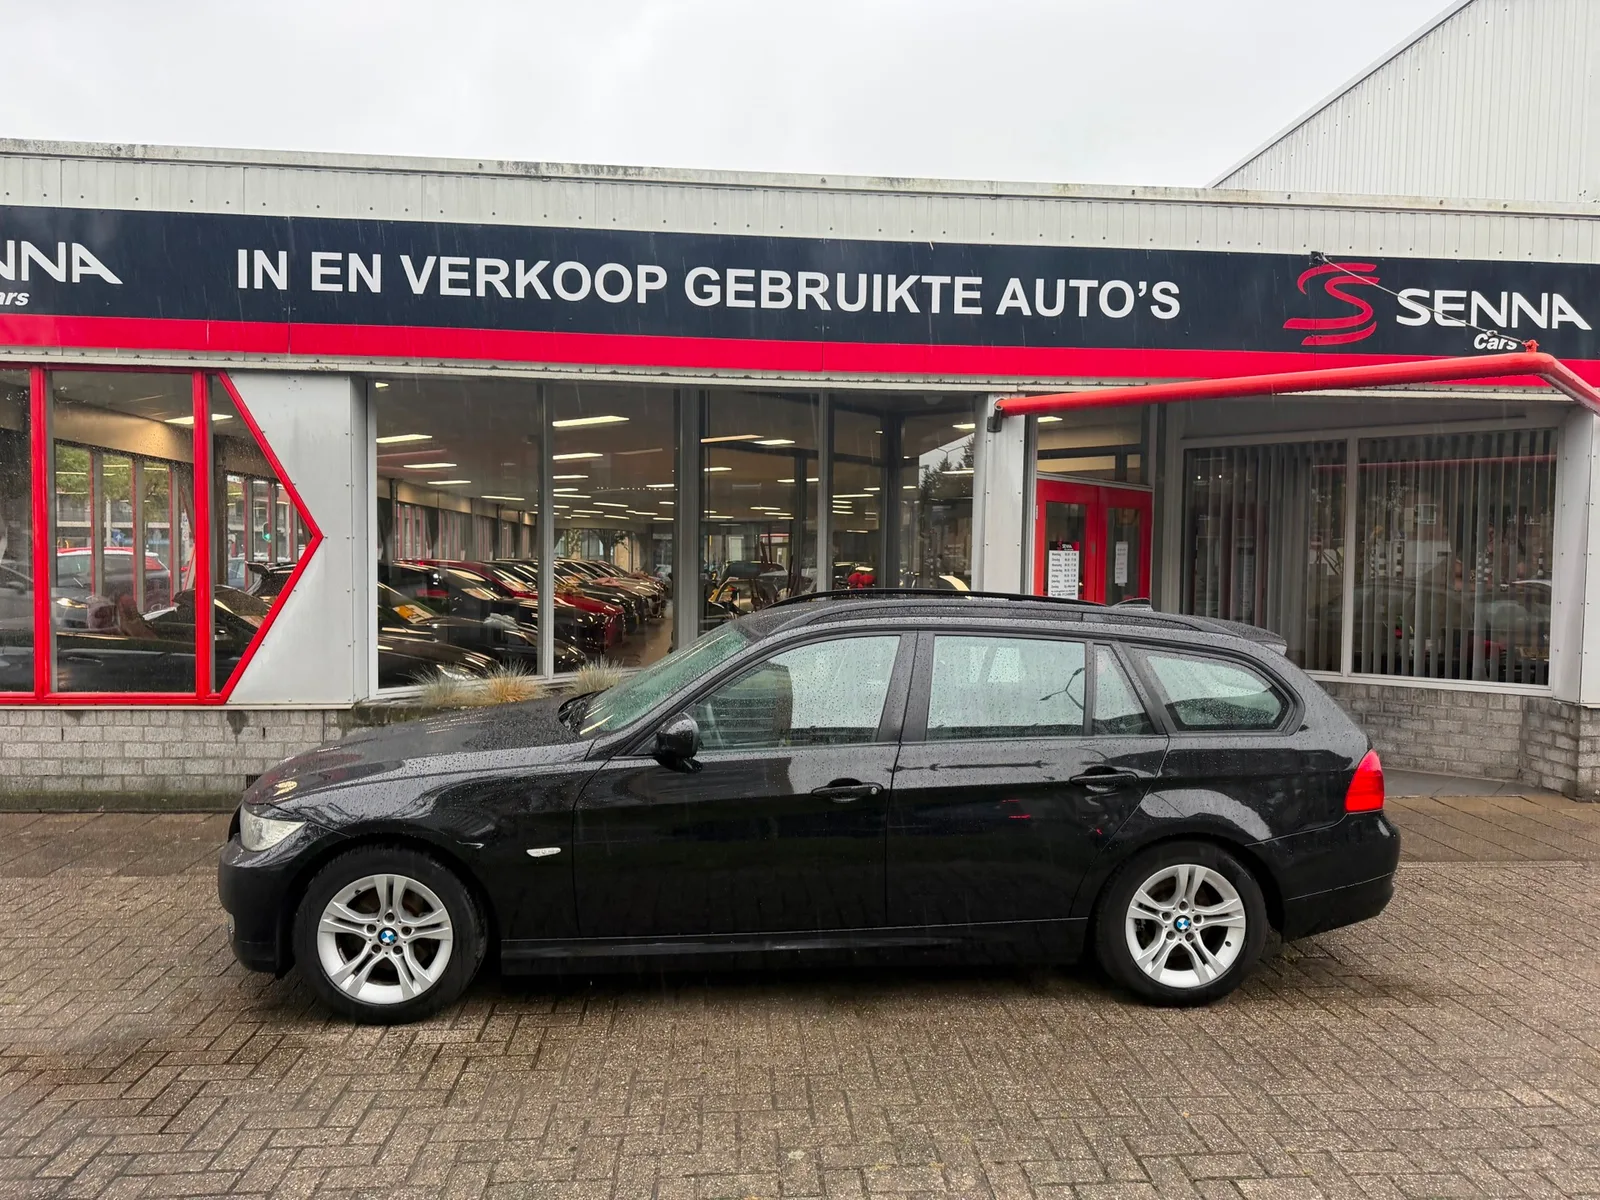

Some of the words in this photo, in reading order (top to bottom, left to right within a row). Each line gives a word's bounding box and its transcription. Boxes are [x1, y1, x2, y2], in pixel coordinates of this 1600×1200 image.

[237, 248, 288, 291] IN
[311, 251, 382, 294] EN
[399, 254, 668, 306] VERKOOP
[684, 266, 983, 316] GEBRUIKTE
[995, 277, 1181, 321] AUTO’S
[1396, 287, 1593, 332] SENNA
[1473, 333, 1518, 351] Cars
